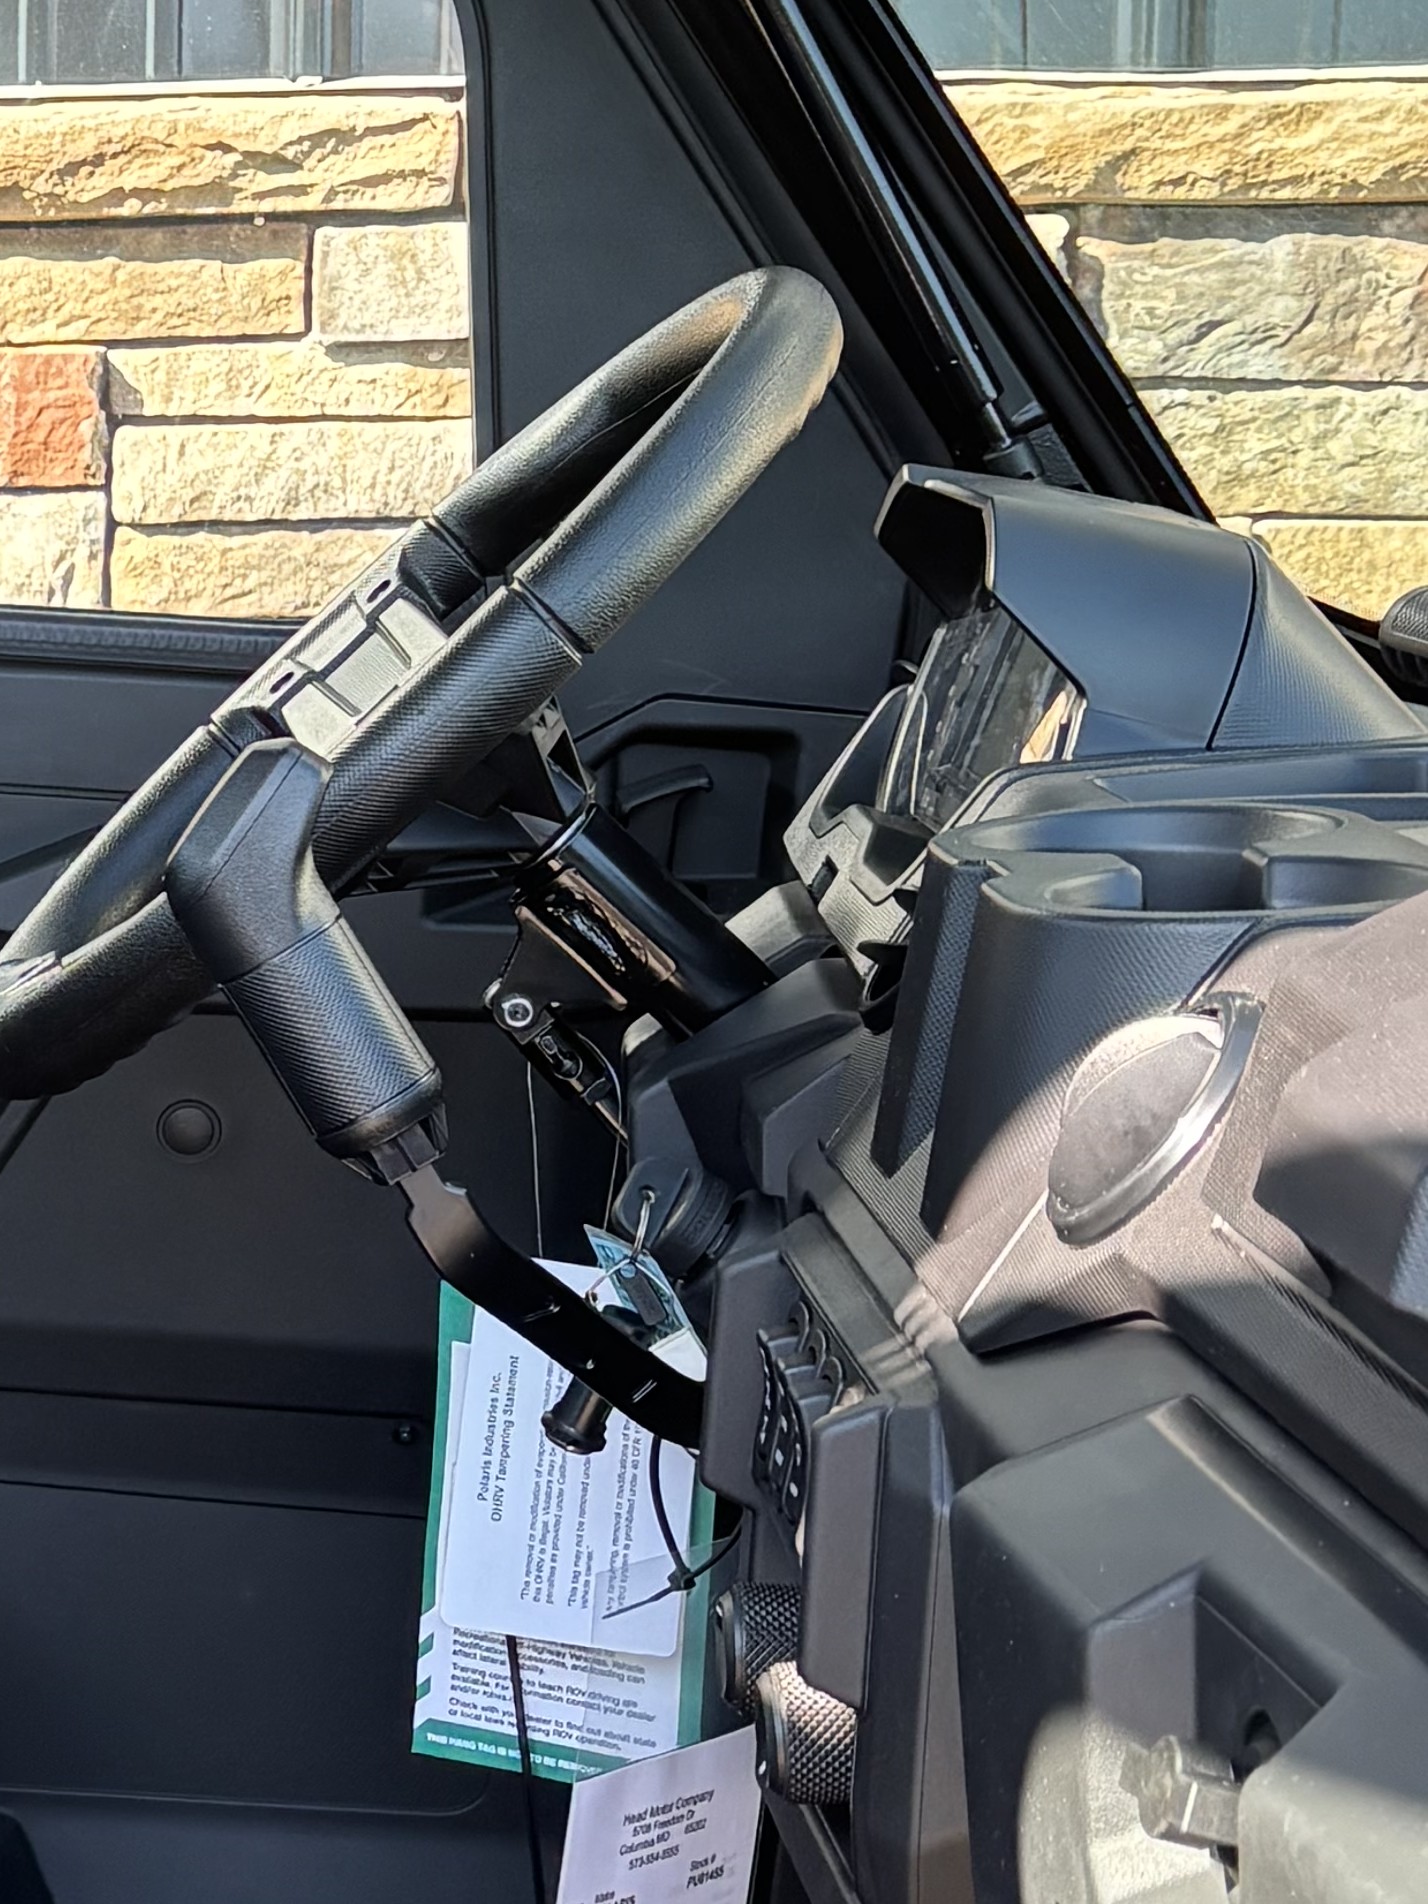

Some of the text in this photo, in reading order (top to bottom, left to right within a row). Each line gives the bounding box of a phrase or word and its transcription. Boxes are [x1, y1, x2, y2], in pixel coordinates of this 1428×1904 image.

[477, 1372, 502, 1501] Polaris Industries Inc.
[491, 1356, 519, 1521] OHRV Tampering Statement
[619, 1838, 655, 1855] Columbia
[656, 1830, 671, 1842] MO
[623, 1790, 714, 1826] Head Motor Company
